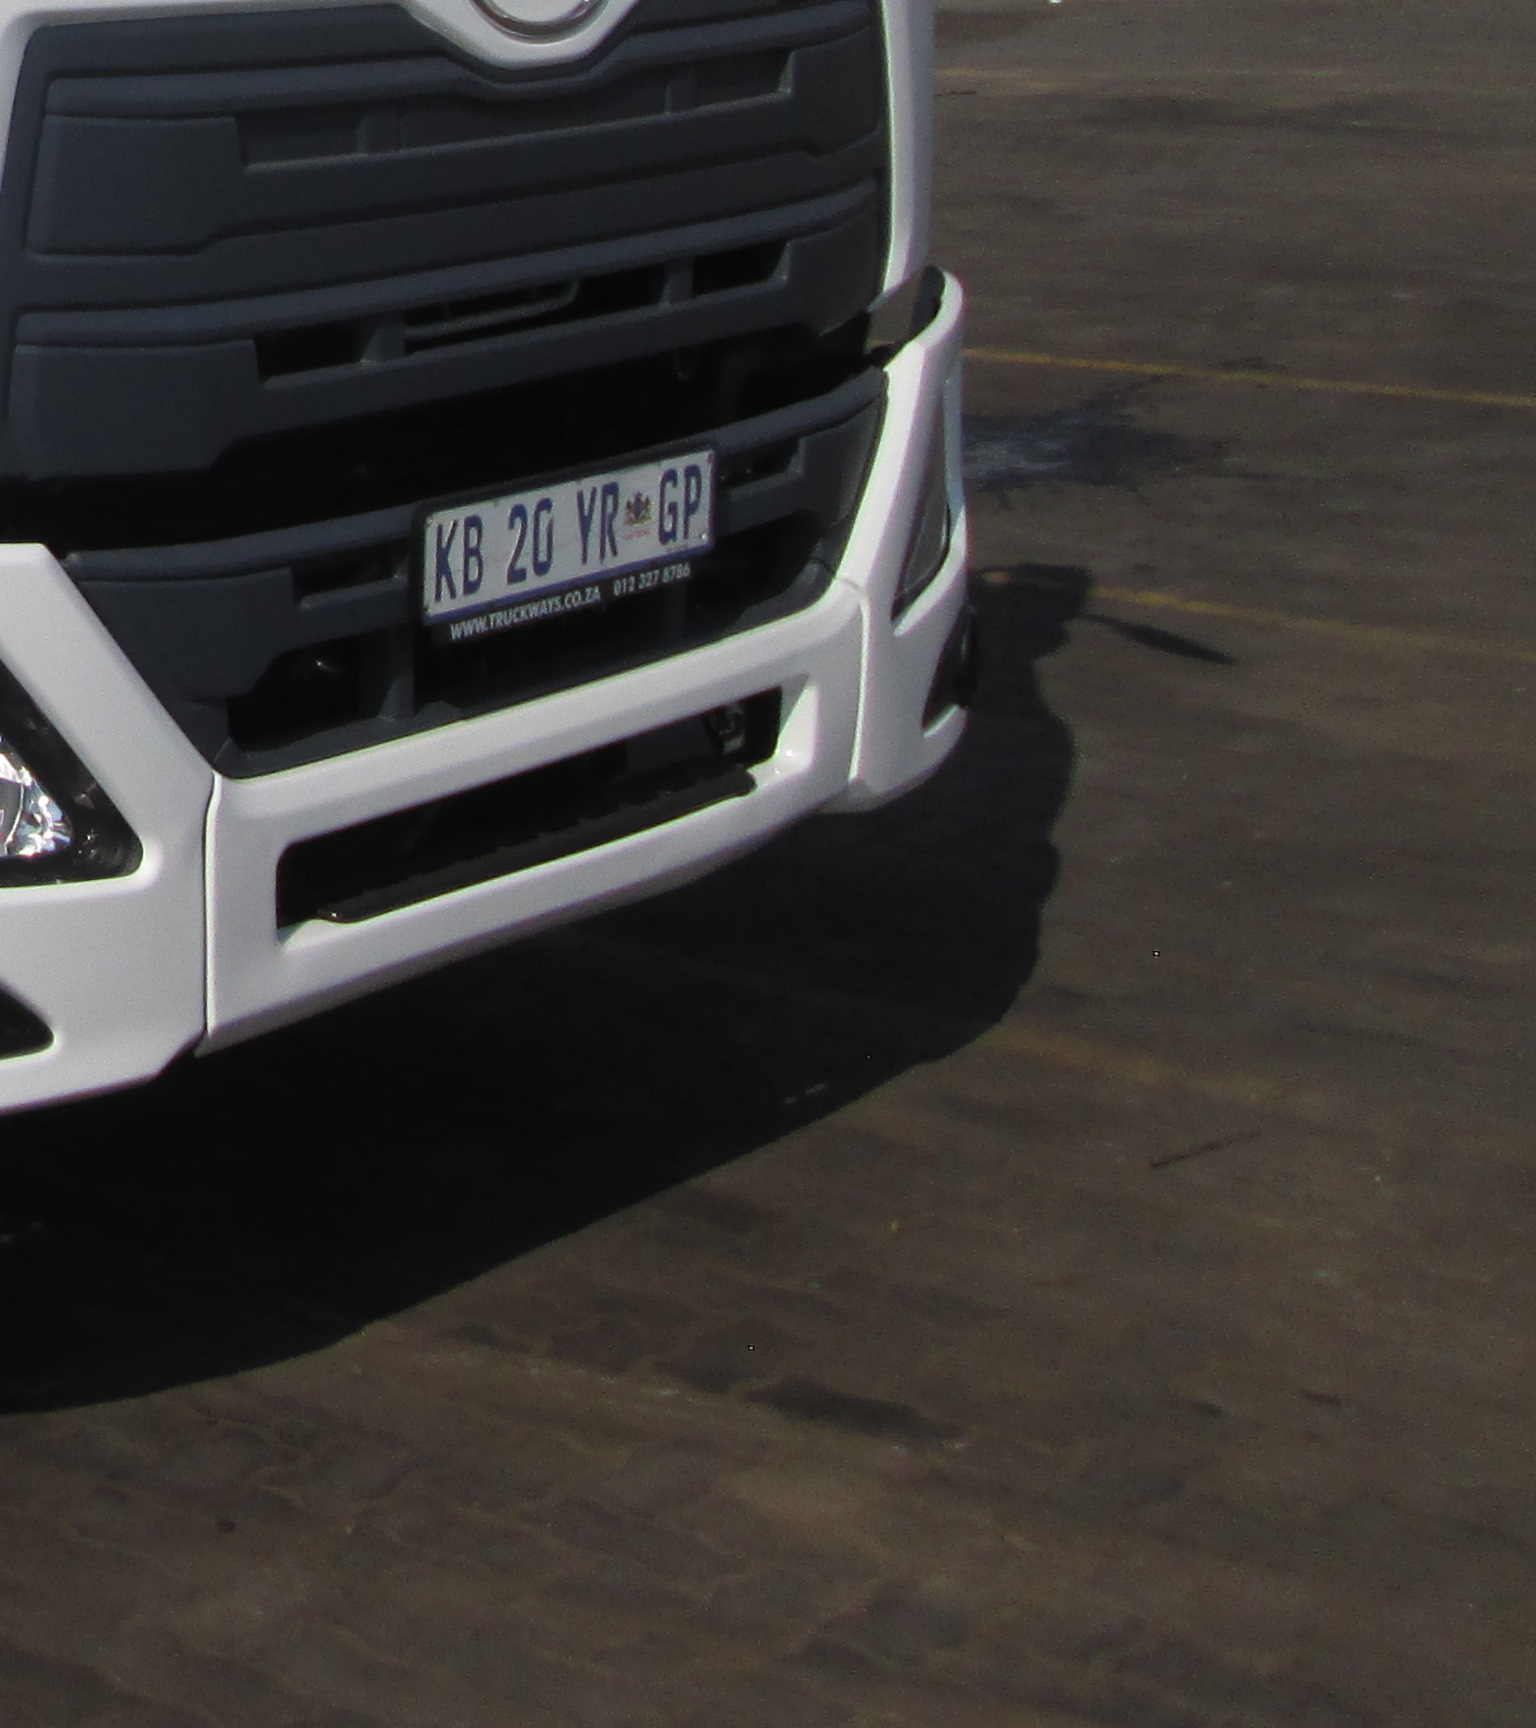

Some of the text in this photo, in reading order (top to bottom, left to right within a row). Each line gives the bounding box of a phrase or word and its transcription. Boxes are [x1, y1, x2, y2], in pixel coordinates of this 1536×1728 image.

[433, 464, 702, 603] KB 20 YR GP
[449, 585, 602, 640] WWW.TRUCKWAYS.CO.ZA
